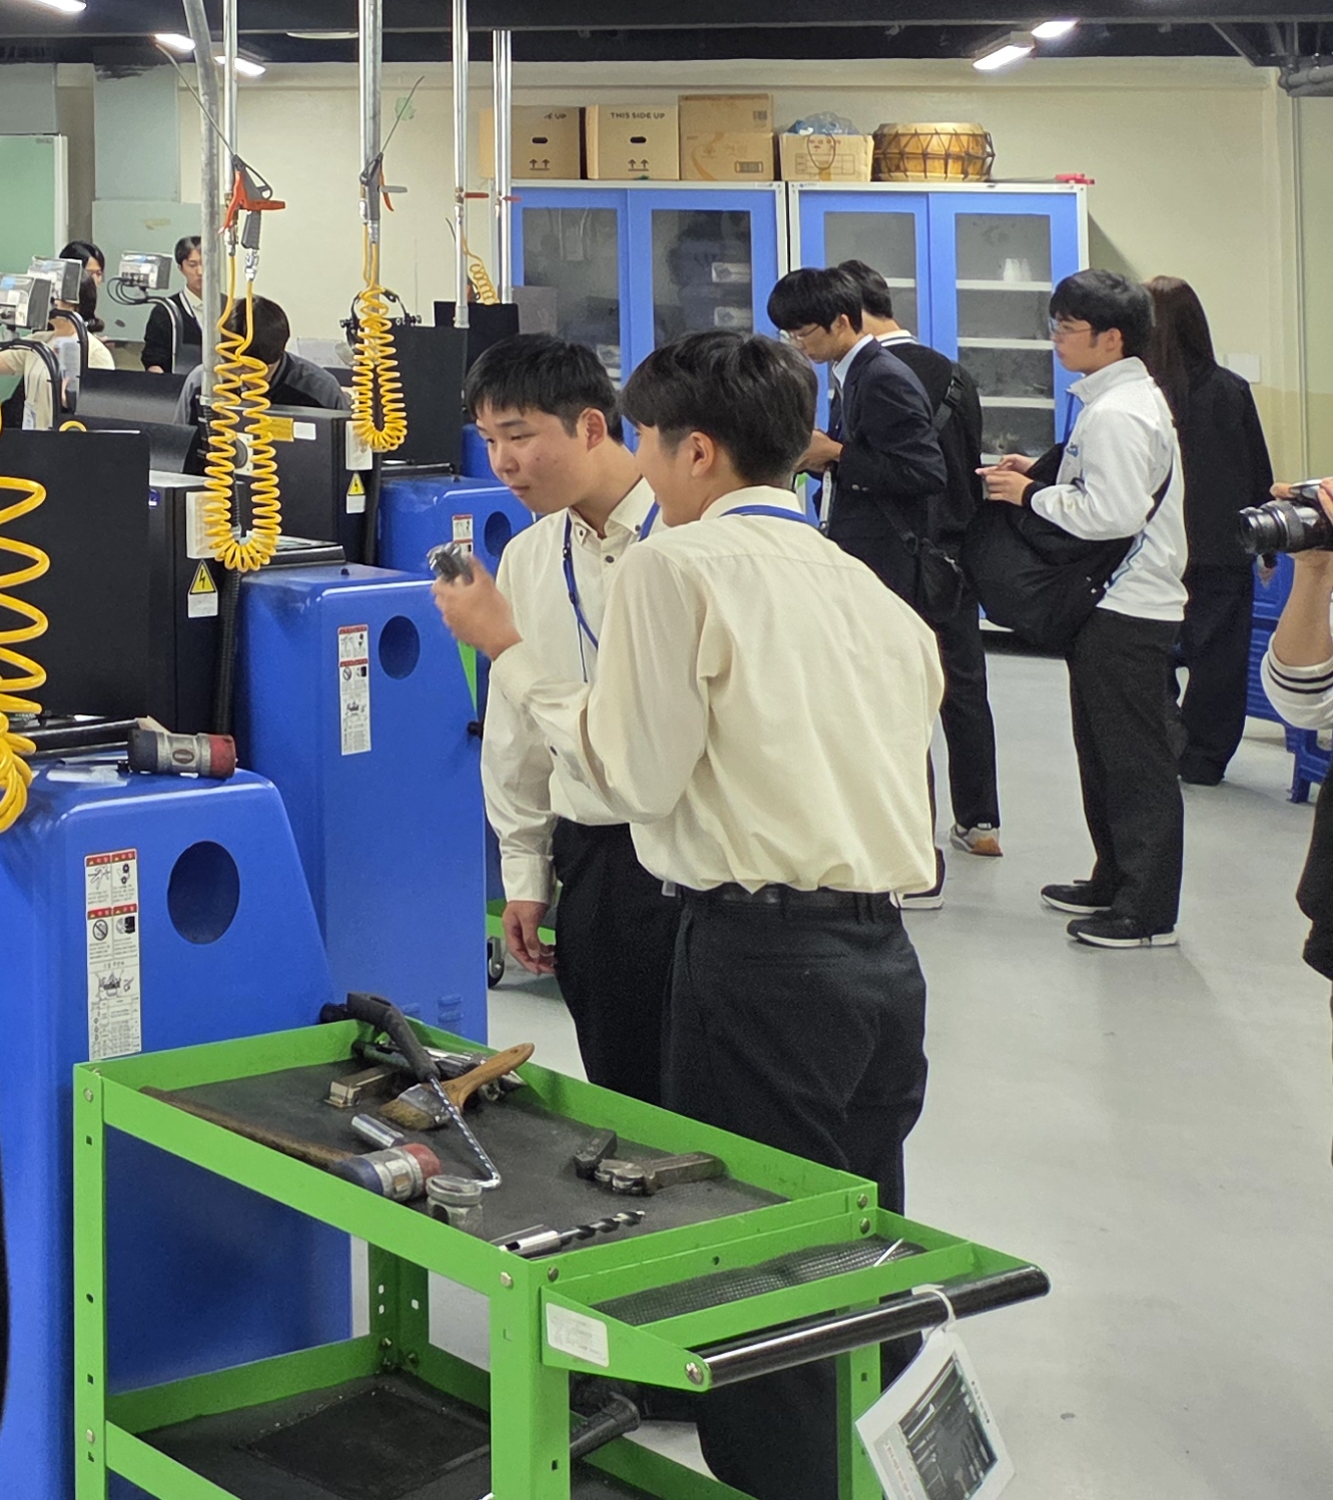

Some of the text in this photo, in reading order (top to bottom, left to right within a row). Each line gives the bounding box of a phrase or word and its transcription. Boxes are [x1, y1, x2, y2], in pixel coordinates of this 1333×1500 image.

[554, 112, 567, 120] UP
[610, 111, 666, 119] THIS SIDE UP
